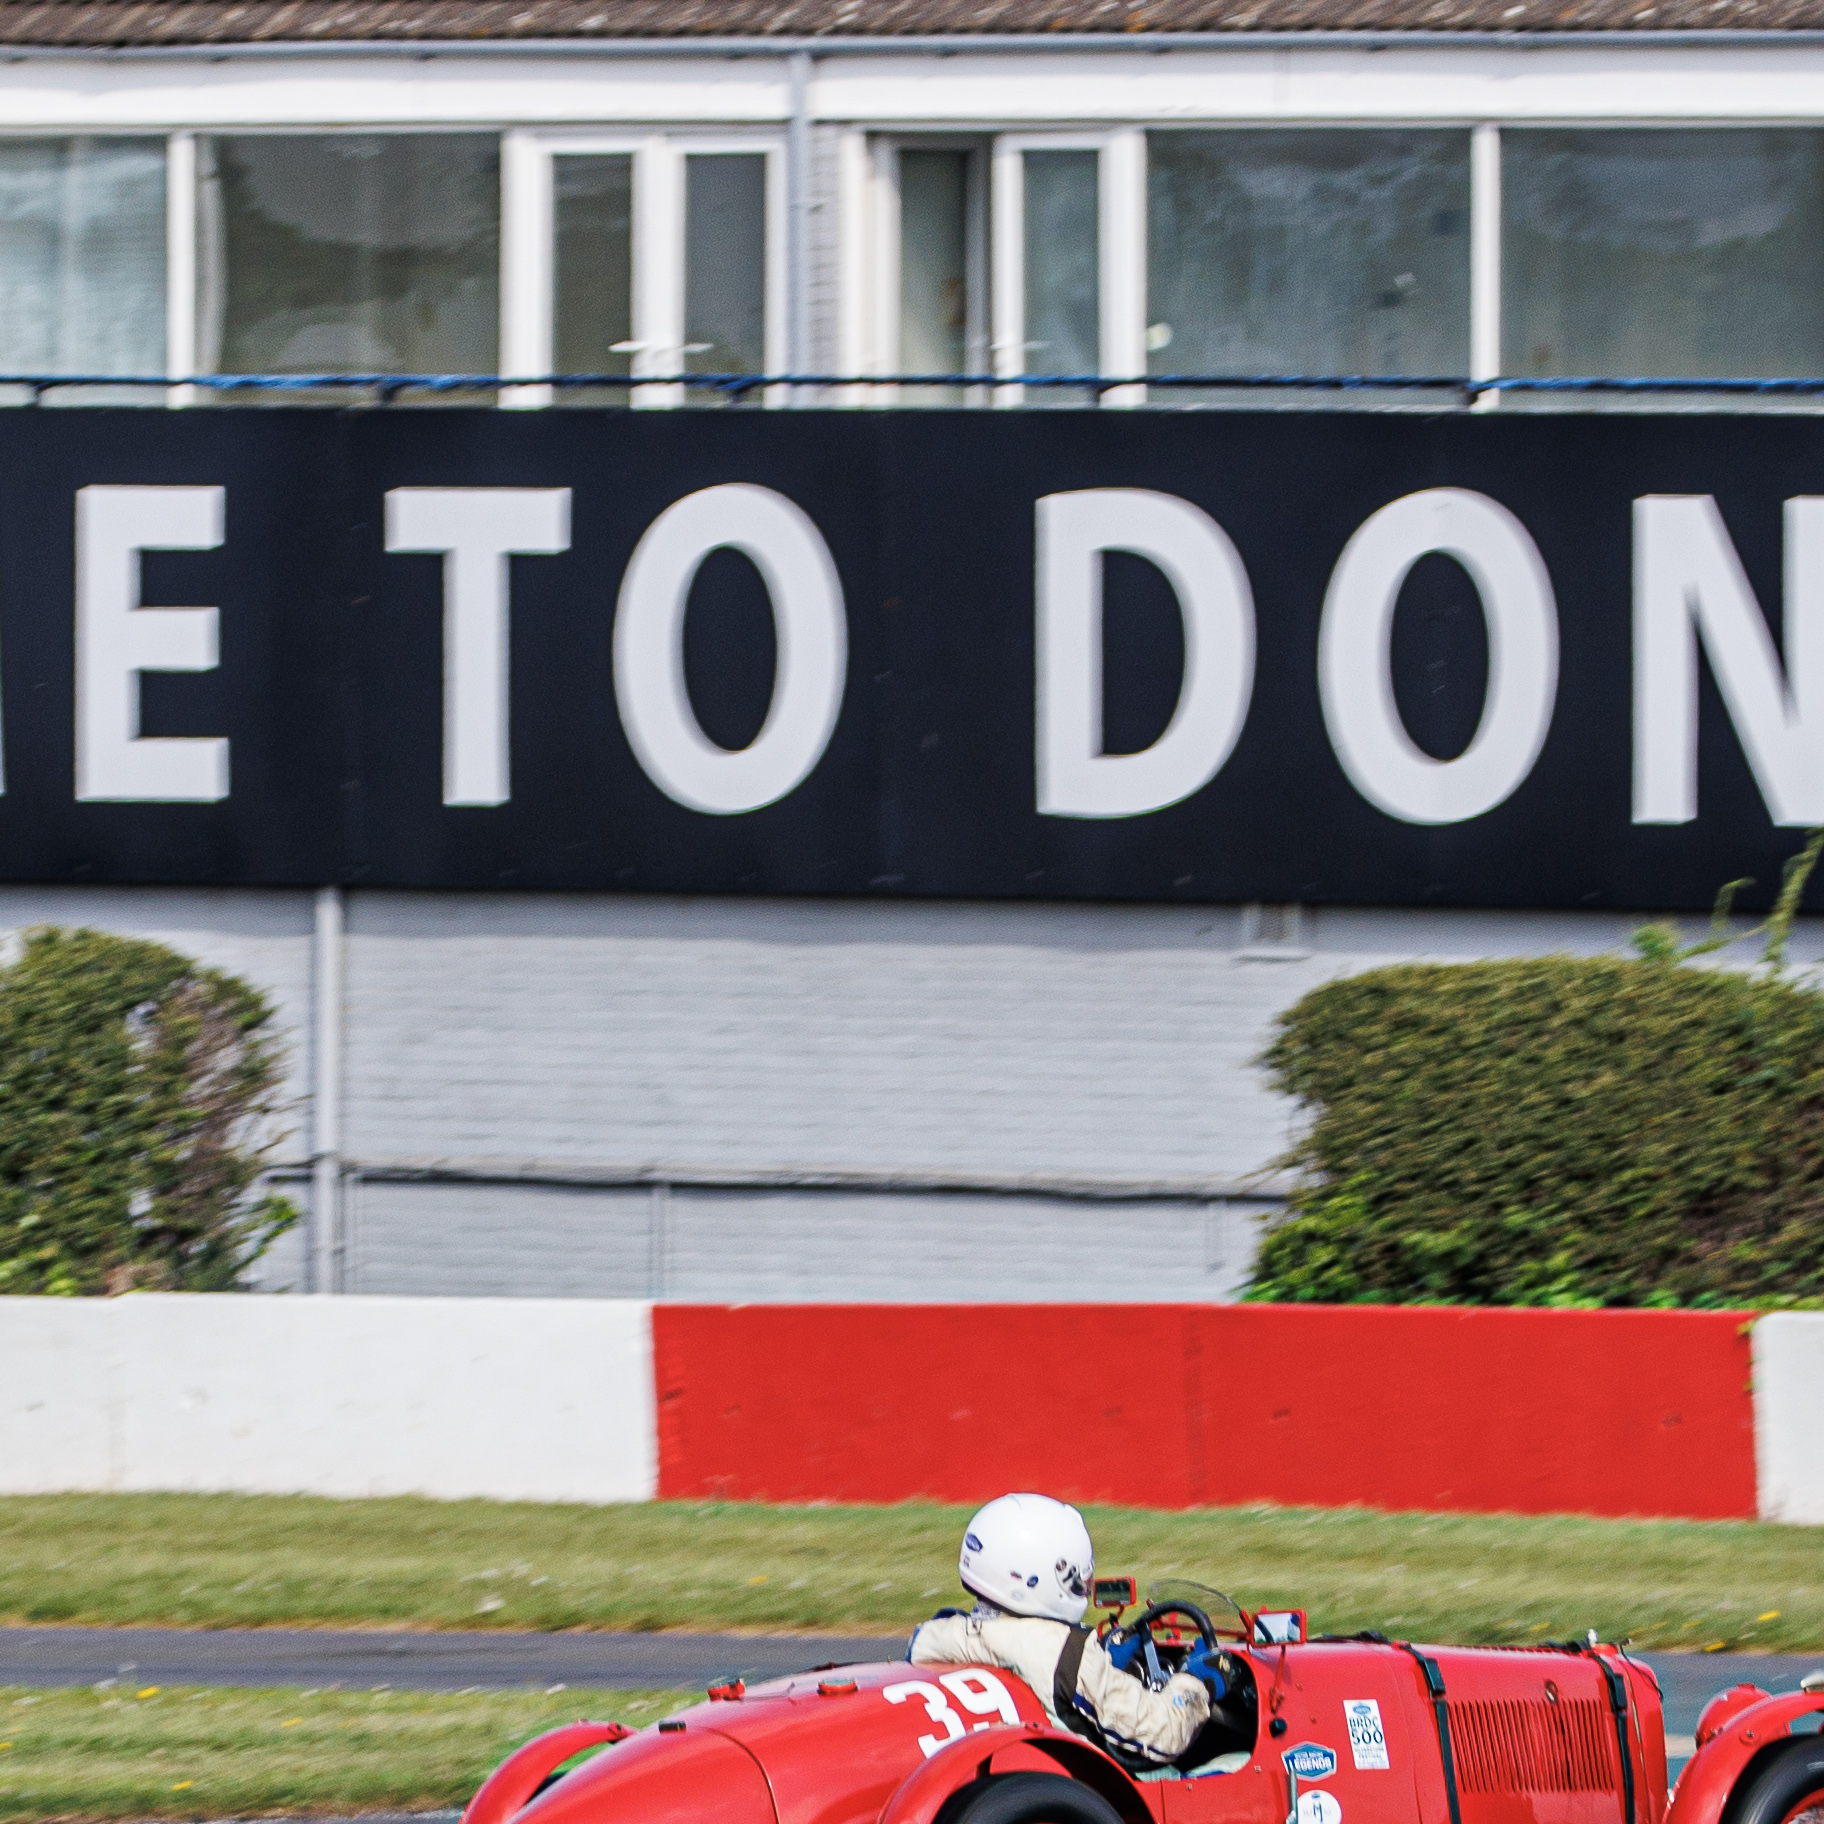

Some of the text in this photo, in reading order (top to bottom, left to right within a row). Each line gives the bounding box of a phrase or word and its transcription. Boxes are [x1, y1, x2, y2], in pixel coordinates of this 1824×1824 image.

[385, 484, 845, 814] TO
[882, 1667, 1021, 1759] 39
[1351, 1729, 1383, 1745] 500
